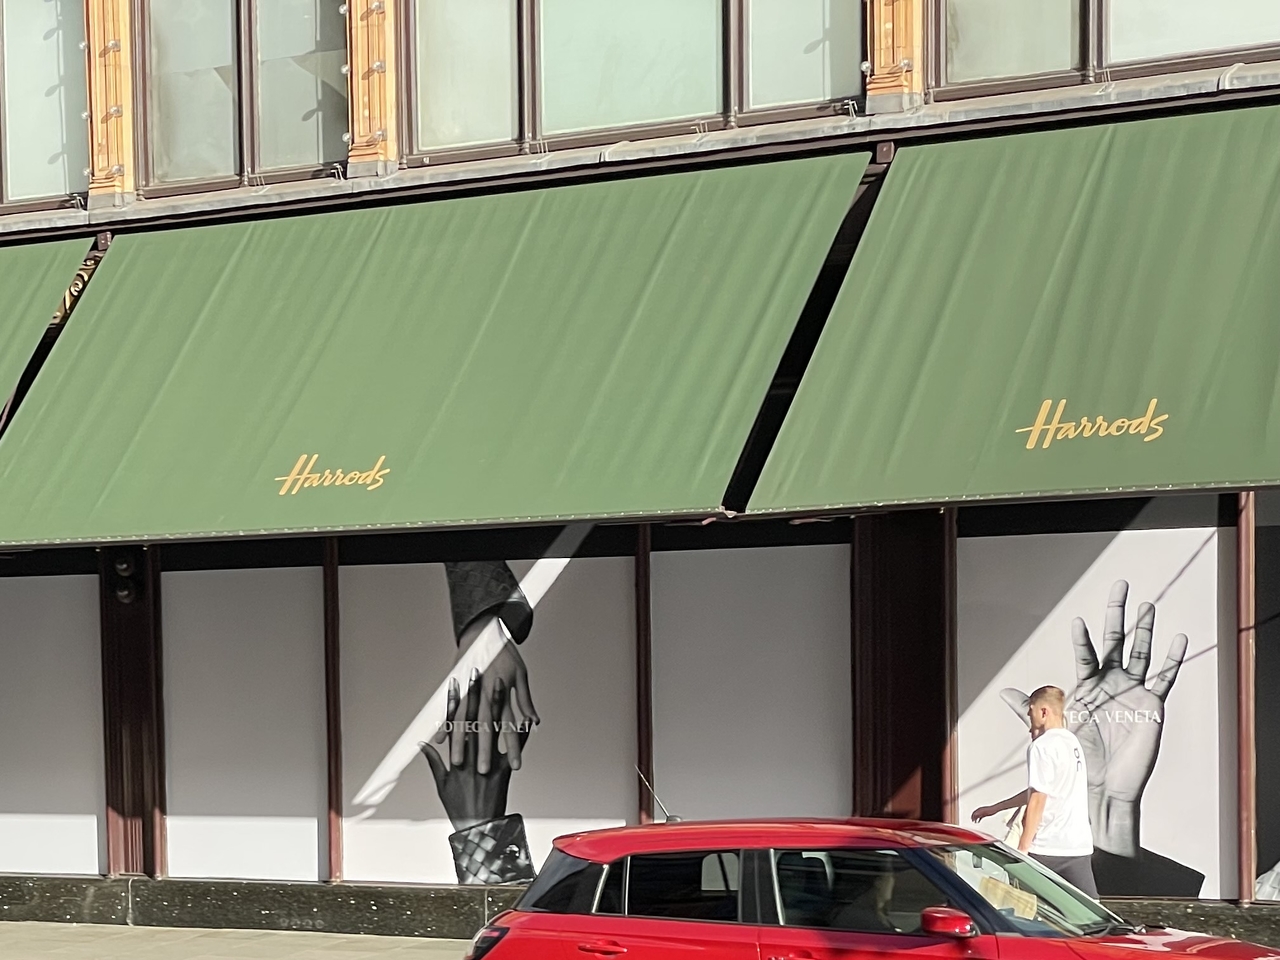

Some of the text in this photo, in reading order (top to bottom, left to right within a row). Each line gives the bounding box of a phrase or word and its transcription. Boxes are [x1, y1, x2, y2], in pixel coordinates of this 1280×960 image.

[1015, 398, 1169, 449] Harrods
[274, 453, 391, 495] Harrods
[1105, 709, 1162, 724] VENETA
